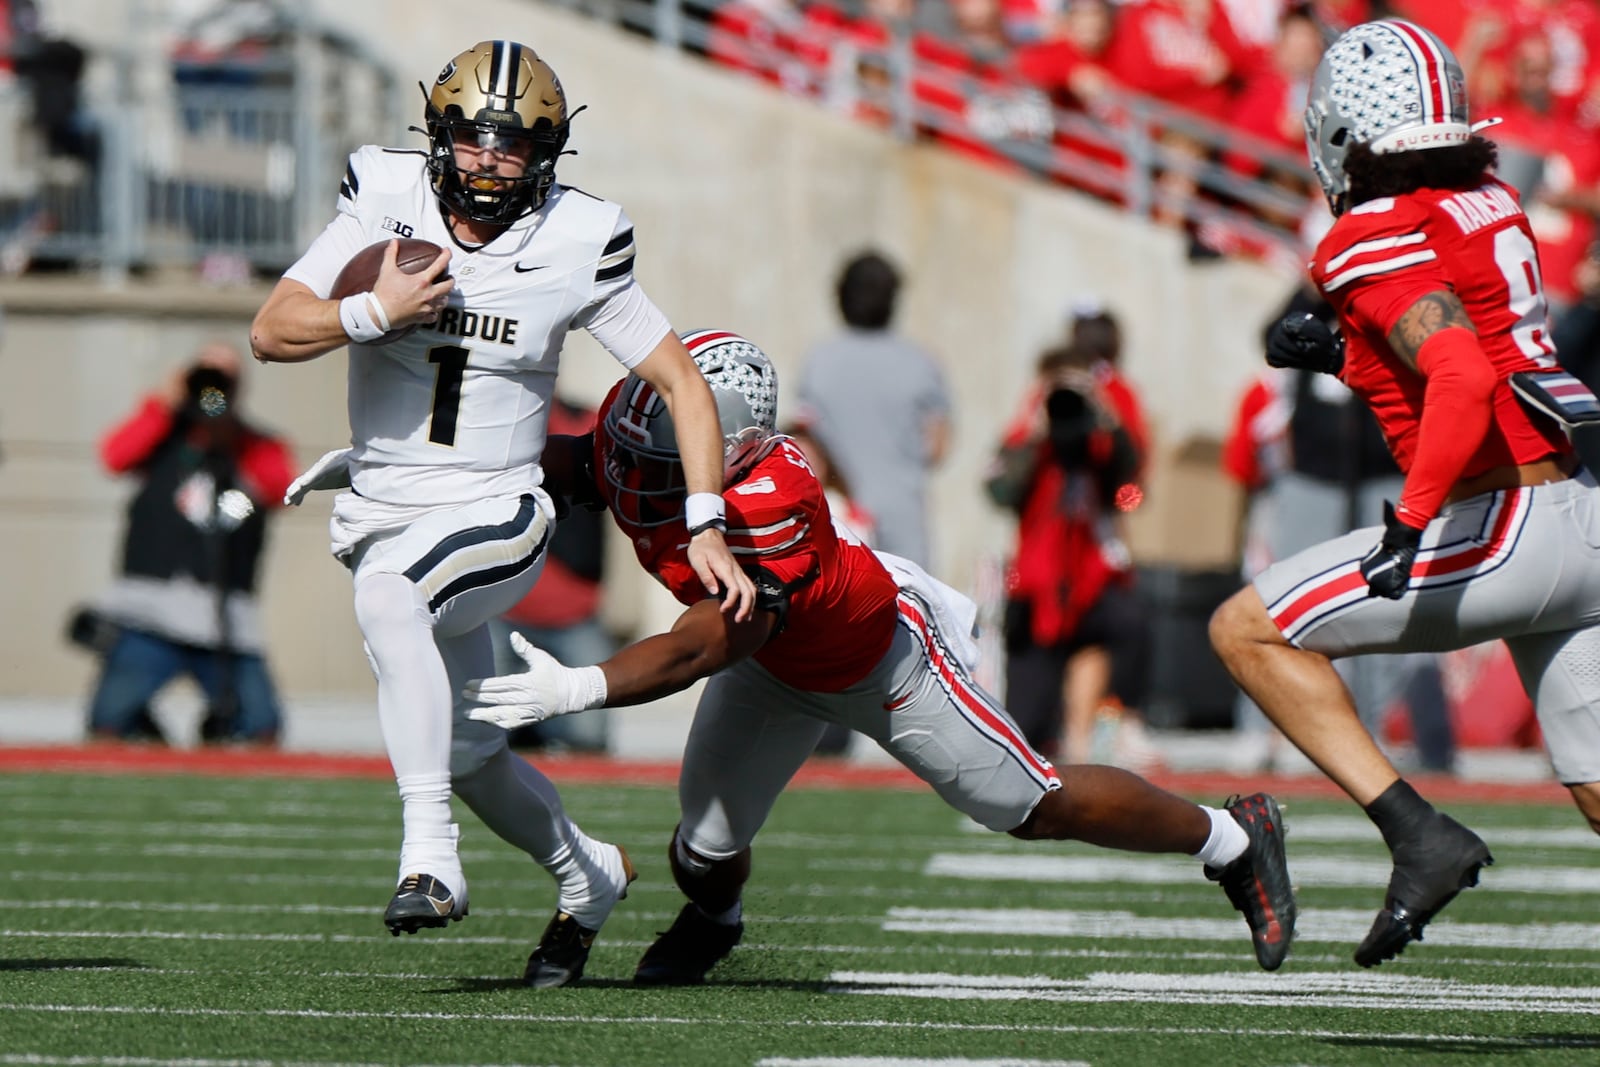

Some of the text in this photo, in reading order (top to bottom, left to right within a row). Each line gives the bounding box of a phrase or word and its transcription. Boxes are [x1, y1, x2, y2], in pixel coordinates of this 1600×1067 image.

[420, 307, 520, 346] RDUE
[1493, 225, 1558, 369] 8
[426, 344, 473, 450] 1
